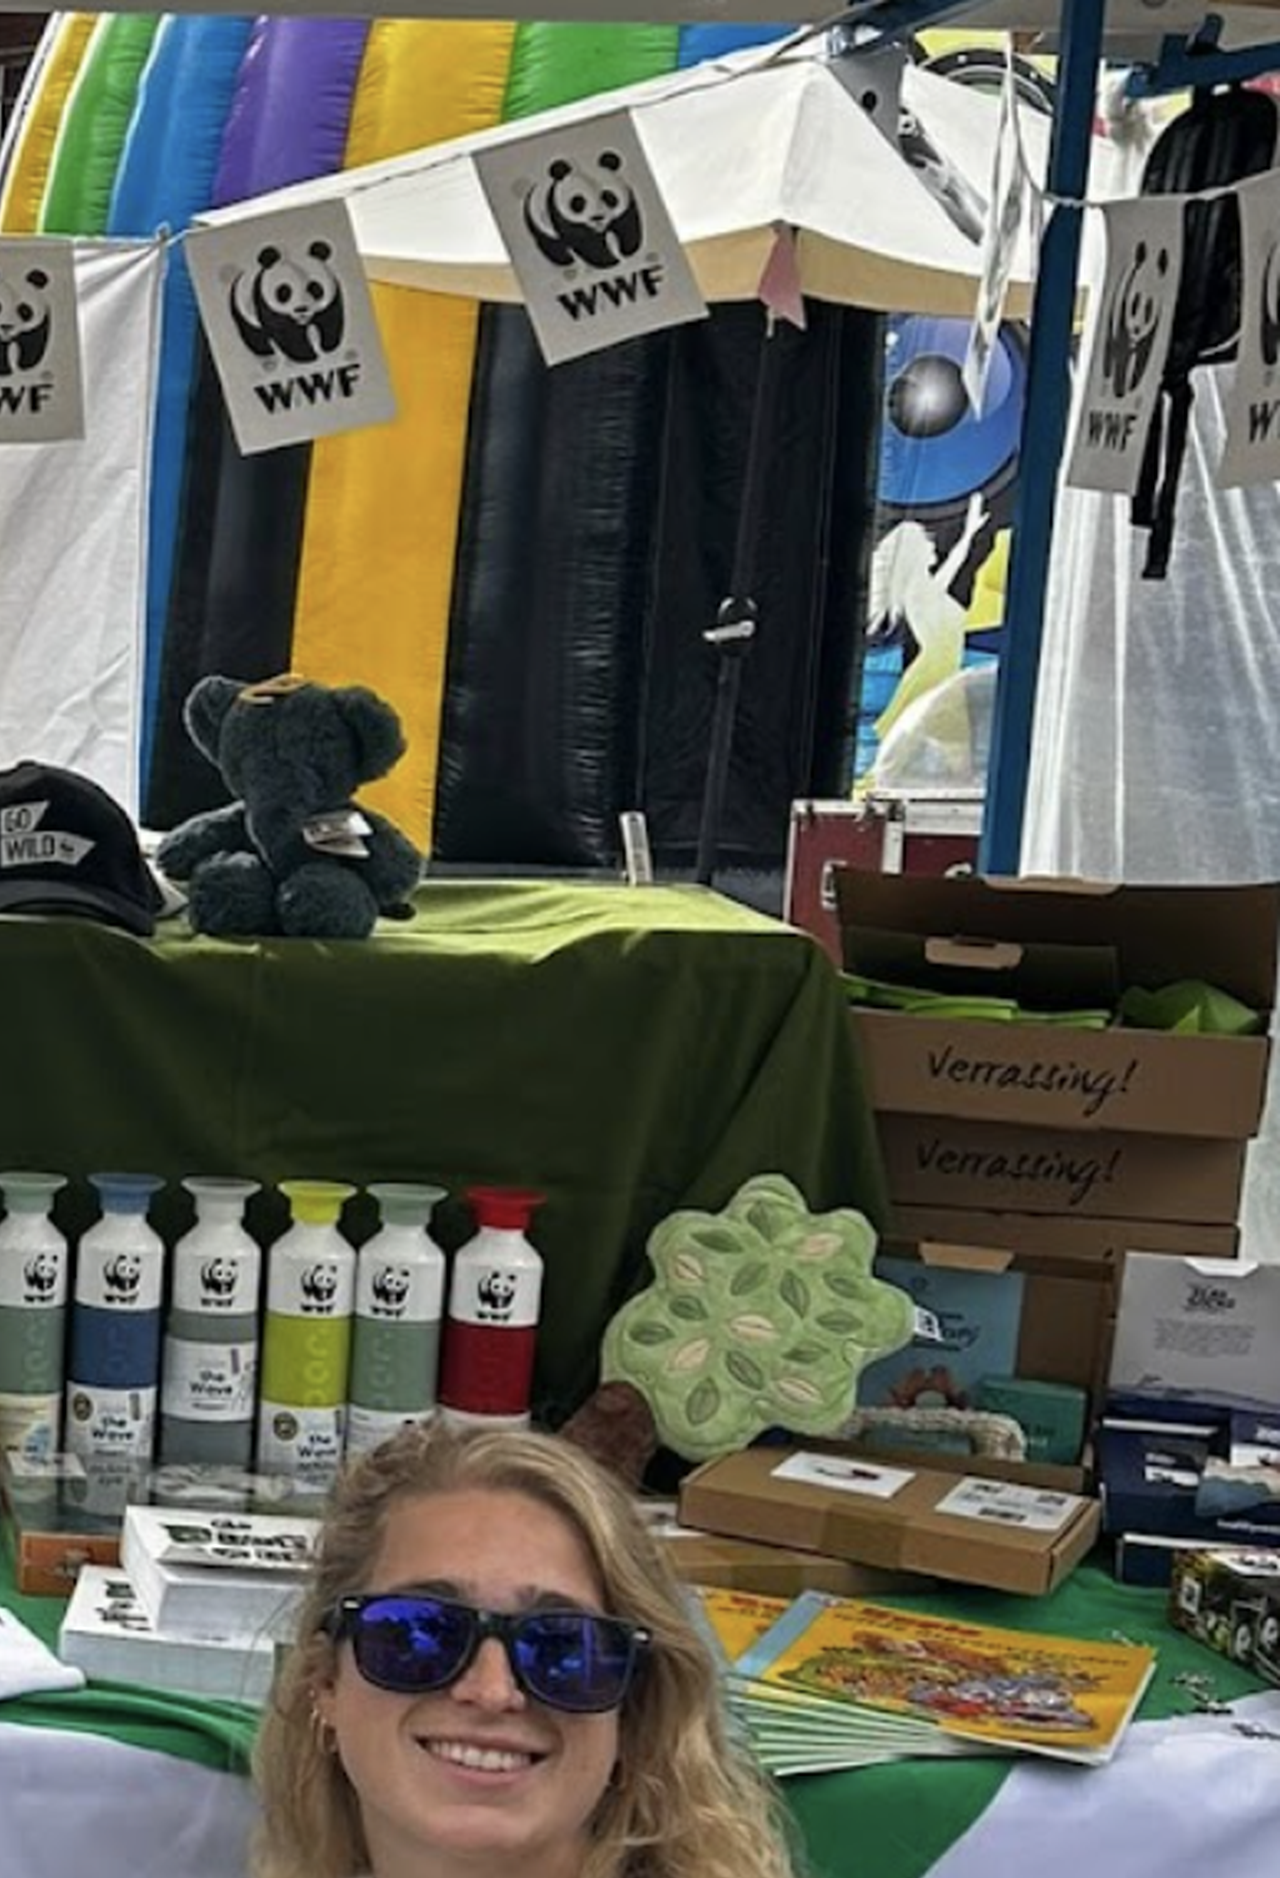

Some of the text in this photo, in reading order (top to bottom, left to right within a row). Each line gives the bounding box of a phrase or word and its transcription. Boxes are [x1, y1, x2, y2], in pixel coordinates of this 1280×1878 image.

[556, 263, 664, 322] WWF
[253, 364, 363, 415] WWF
[1089, 410, 1137, 451] WWF
[3, 807, 32, 832] GO
[4, 834, 56, 862] WILD
[927, 1045, 1138, 1118] Verrassing!
[916, 1138, 1122, 1206] Verrassing!
